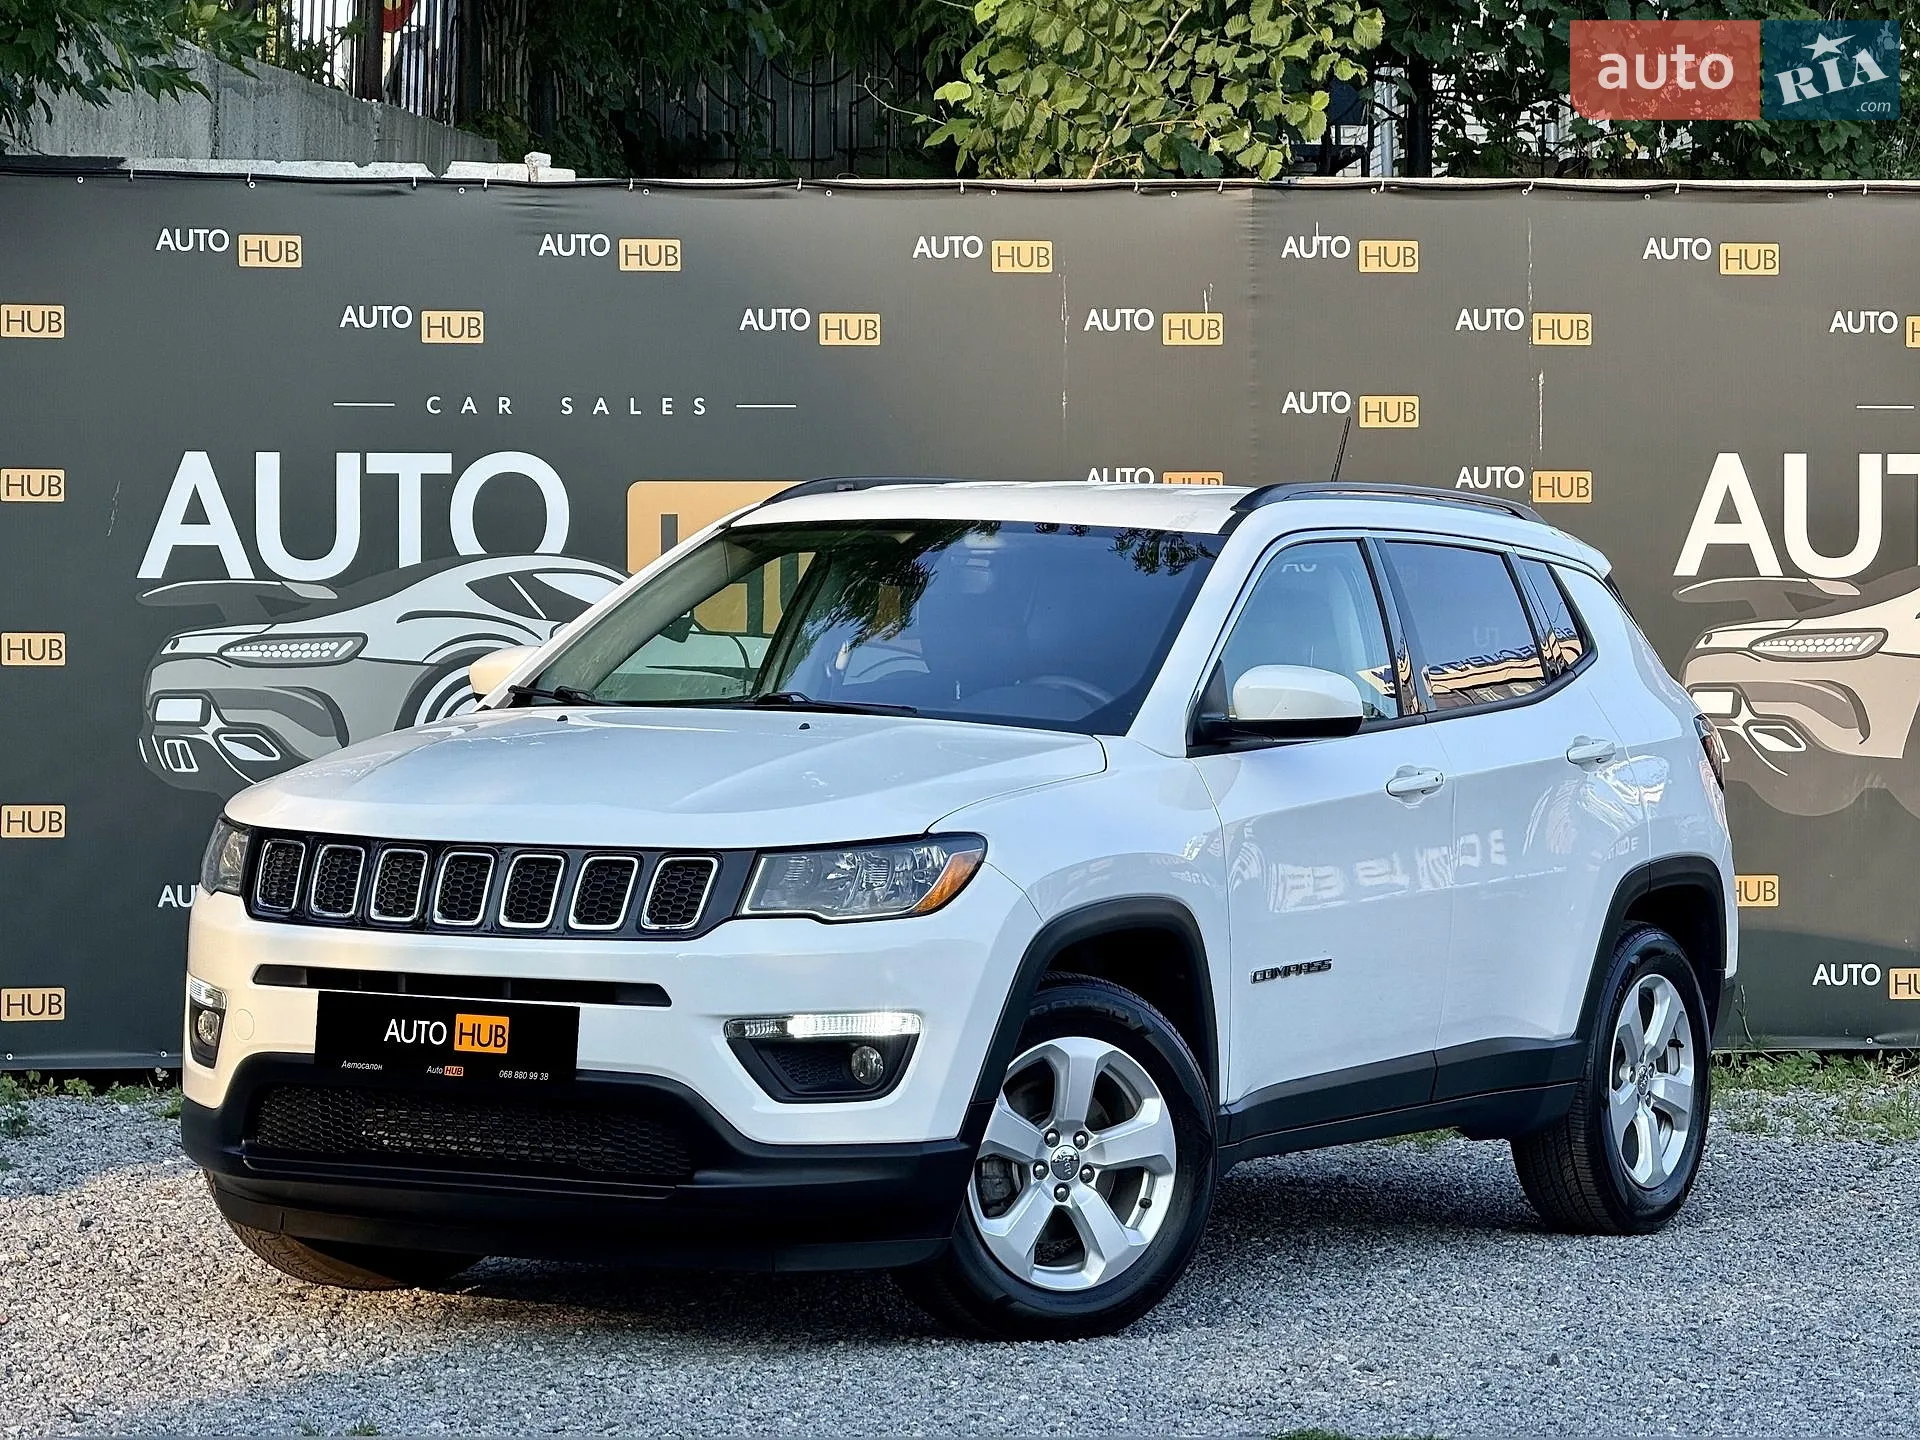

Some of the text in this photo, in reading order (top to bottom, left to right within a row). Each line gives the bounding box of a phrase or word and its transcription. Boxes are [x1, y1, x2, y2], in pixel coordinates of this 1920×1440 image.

[156, 229, 298, 262] AUTO HUB
[539, 234, 677, 266] AUTO HUB
[913, 236, 1049, 267] AUTO HUB
[1282, 236, 1415, 267] AUTO HUB
[1643, 238, 1776, 269] AUTO HUB
[7, 311, 61, 332] HUB
[340, 306, 480, 338] AUTO HUB
[740, 308, 877, 340] AUTO HUB
[1084, 309, 1220, 340] AUTO HUB
[1456, 308, 1588, 340] AUTO HUB
[1830, 311, 1898, 333] AUTO
[427, 397, 705, 415] CAR SALES
[1282, 391, 1415, 422] AUTO HUB
[7, 475, 61, 496] HUB
[1456, 467, 1589, 497] AUTO HUB
[136, 451, 570, 581] AUTO
[8, 639, 62, 660] HUB
[7, 811, 62, 832] HUB
[1251, 958, 1333, 984] COMPASS
[1813, 964, 1880, 985] AUTO
[7, 994, 62, 1016] HUB
[384, 1019, 506, 1048] AUTO HUB
[427, 1065, 463, 1075] Auto HUB
